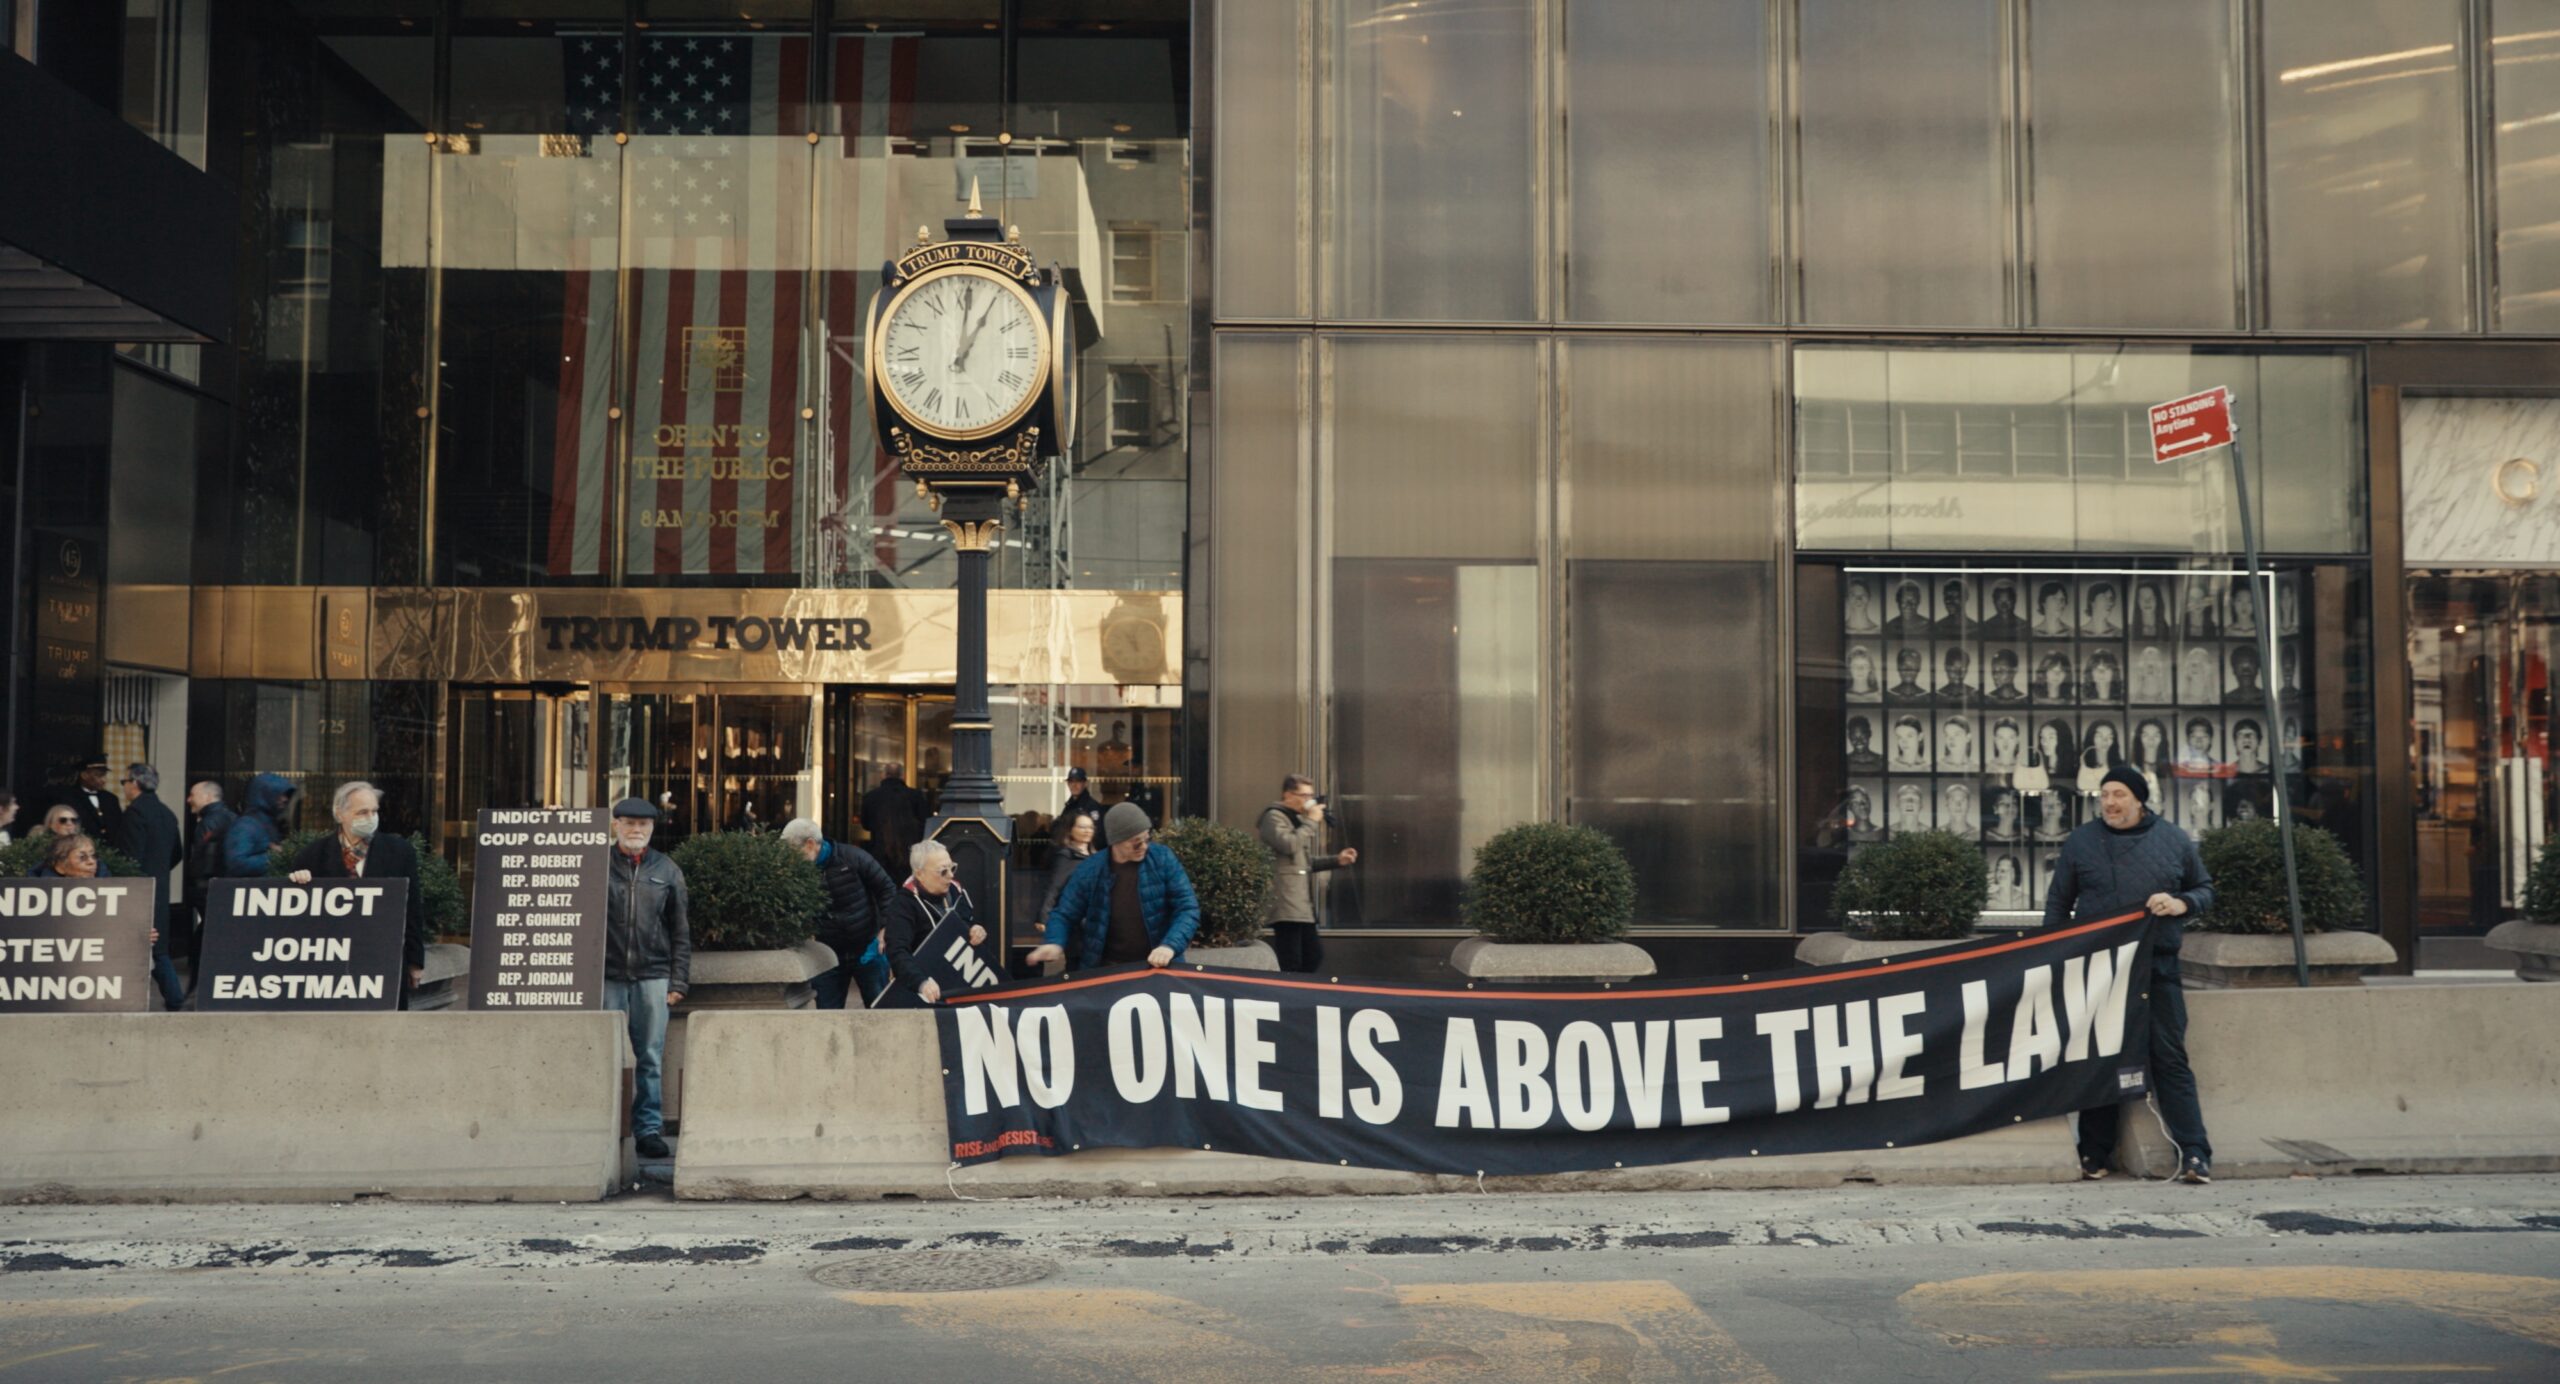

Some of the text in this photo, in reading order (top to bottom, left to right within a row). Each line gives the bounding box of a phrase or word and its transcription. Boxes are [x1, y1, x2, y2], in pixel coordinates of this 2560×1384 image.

[906, 246, 1018, 272] TRUMP TOWER
[2154, 396, 2216, 423] NO STANDING
[2156, 416, 2196, 435] Anytime
[654, 424, 770, 448] OPEN TO
[632, 456, 792, 480] THE PUBLIC
[541, 616, 872, 651] TRUMP TOWER
[48, 645, 89, 662] TRUMP
[318, 719, 346, 735] 725
[1070, 723, 1097, 738] 725
[492, 810, 592, 824] INDICT THE
[480, 832, 607, 846] COUP CAUCUS
[502, 855, 583, 868] REP. BOEBERT
[502, 874, 580, 887] REP. BROOKS
[232, 886, 383, 916] INDICT
[508, 894, 572, 907] REP. GAETZ
[496, 914, 582, 926] REP. GOHMERT
[503, 933, 572, 946] REP. GOSAR
[252, 938, 352, 962] JOHN
[500, 952, 574, 966] REP. GREENE
[212, 974, 384, 999] EASTMAN
[498, 972, 573, 985] REP. JORDAN
[486, 992, 583, 1005] SEN. TUBERVILLE
[955, 940, 2140, 1132] NO ONE IS ABOVE THE LAW
